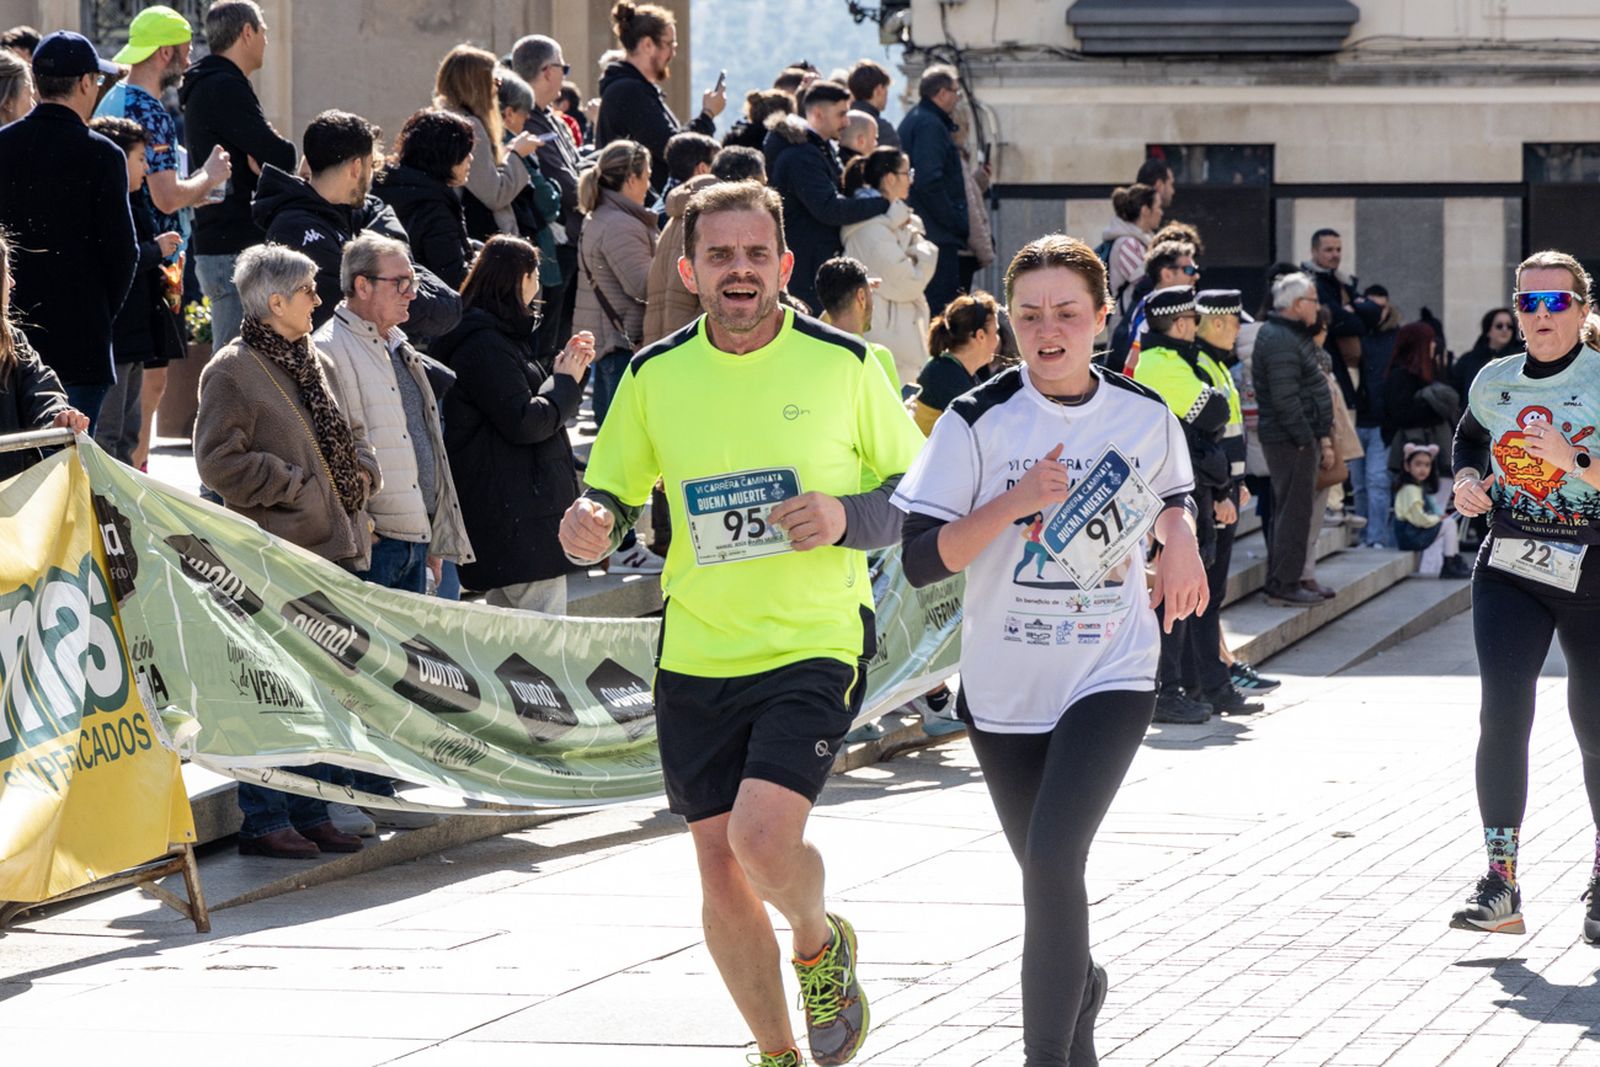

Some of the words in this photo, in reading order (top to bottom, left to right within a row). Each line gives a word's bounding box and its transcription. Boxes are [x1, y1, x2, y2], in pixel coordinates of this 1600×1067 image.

[695, 486, 704, 494] VI
[704, 480, 740, 493] CARRERA
[741, 473, 784, 486] CAMINATA
[697, 494, 728, 511] BUENA
[728, 488, 767, 506] MUERTE
[1057, 494, 1083, 525] CARRERA
[1082, 461, 1113, 494] CAMINATA
[723, 507, 766, 541] 95
[1056, 515, 1083, 544] BUENA
[1079, 483, 1113, 519] MUERTE
[1086, 499, 1124, 547] 97
[1521, 539, 1552, 568] 22
